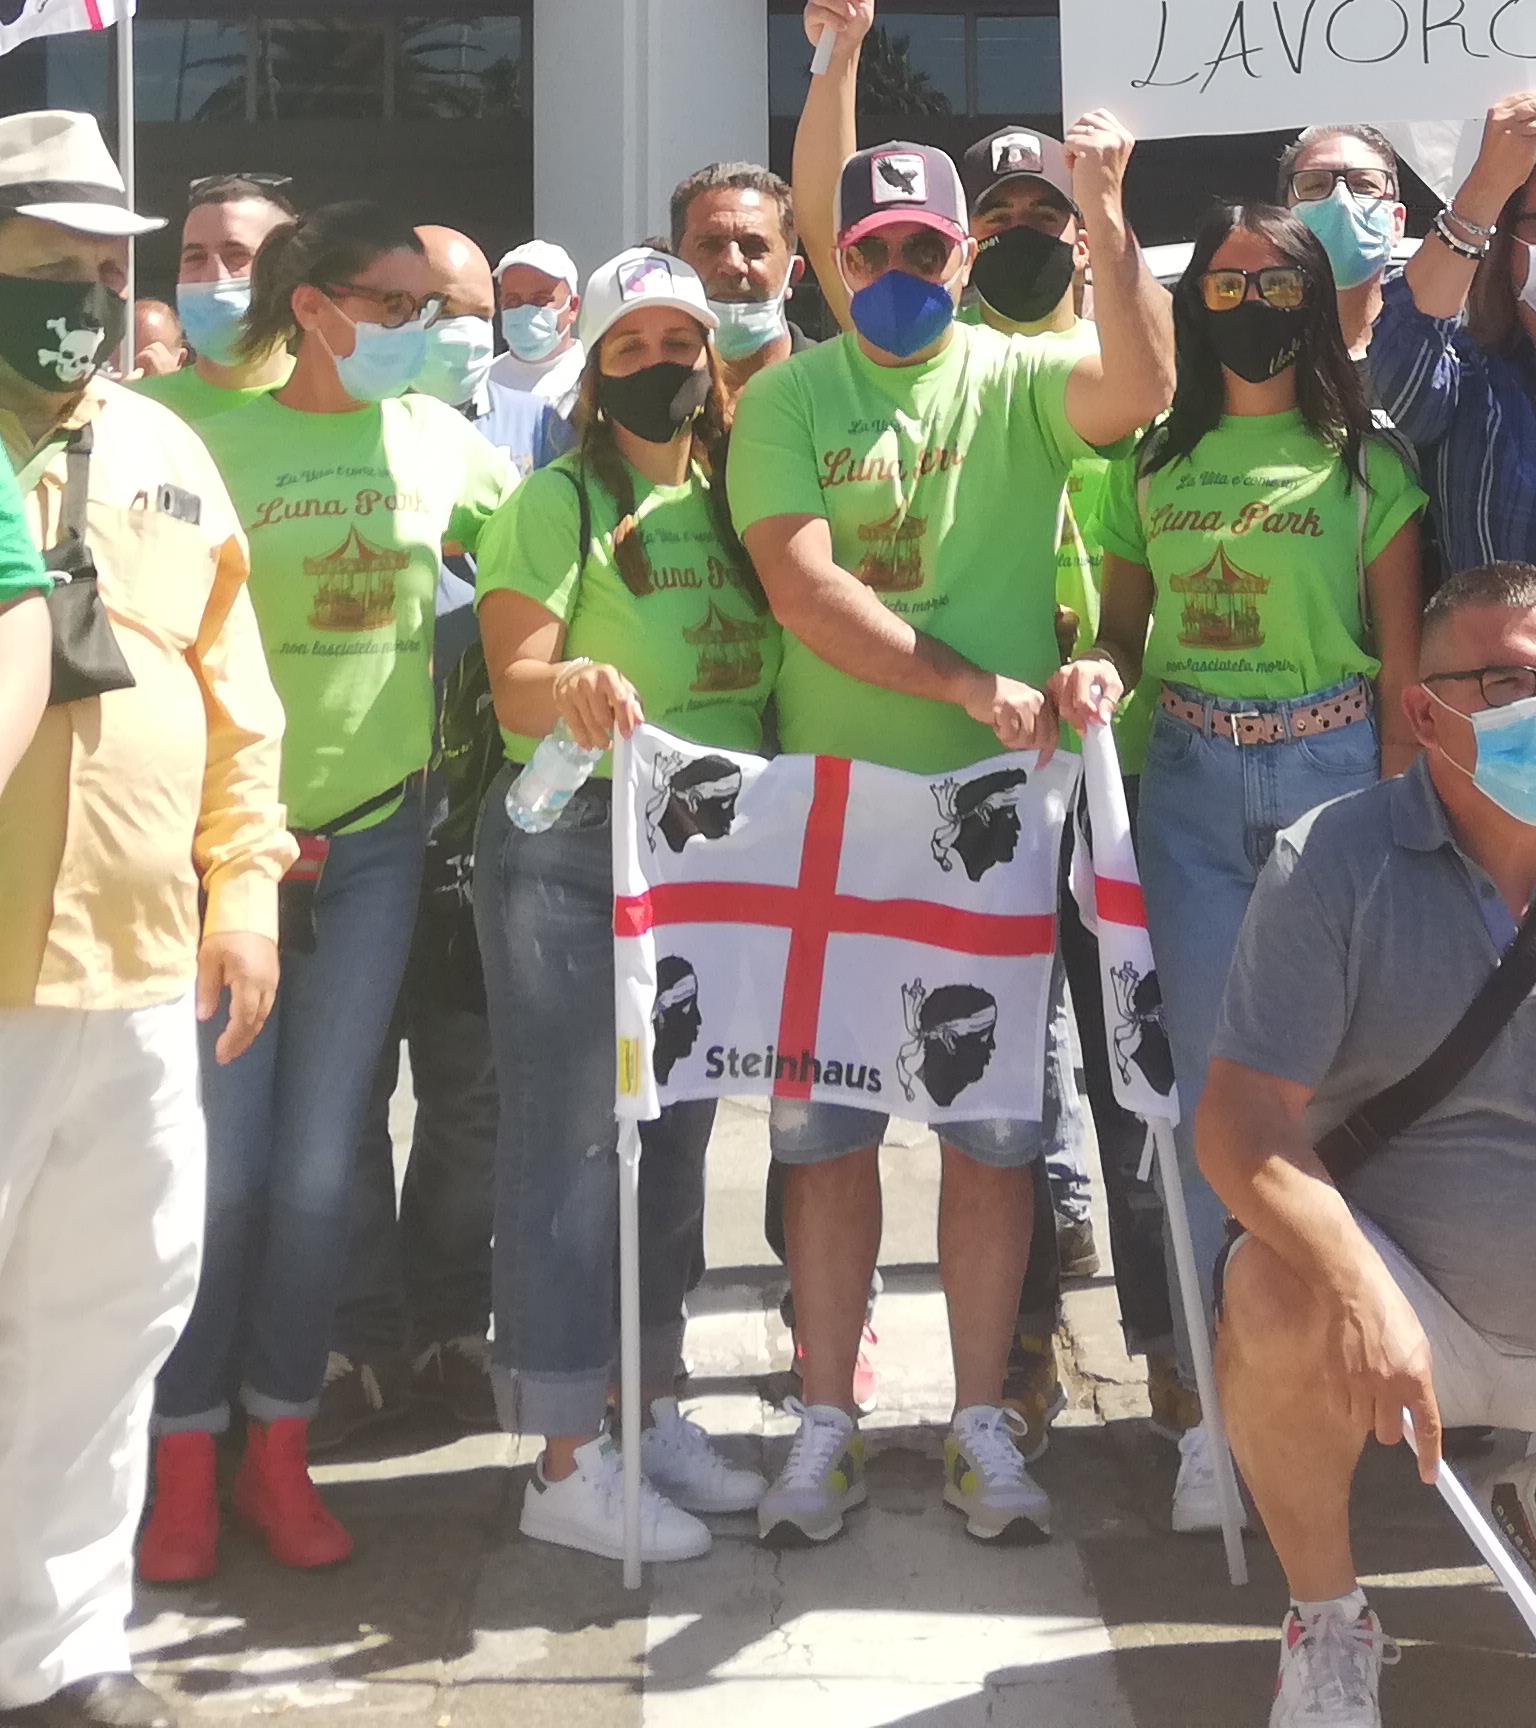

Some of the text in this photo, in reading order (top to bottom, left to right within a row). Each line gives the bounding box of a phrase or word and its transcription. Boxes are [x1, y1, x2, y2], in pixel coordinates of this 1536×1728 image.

[820, 446, 908, 490] Luna
[245, 496, 349, 532] Luna
[1148, 500, 1325, 544] Luna Park
[650, 566, 703, 591] una
[704, 1044, 883, 1093] Steinhaus
